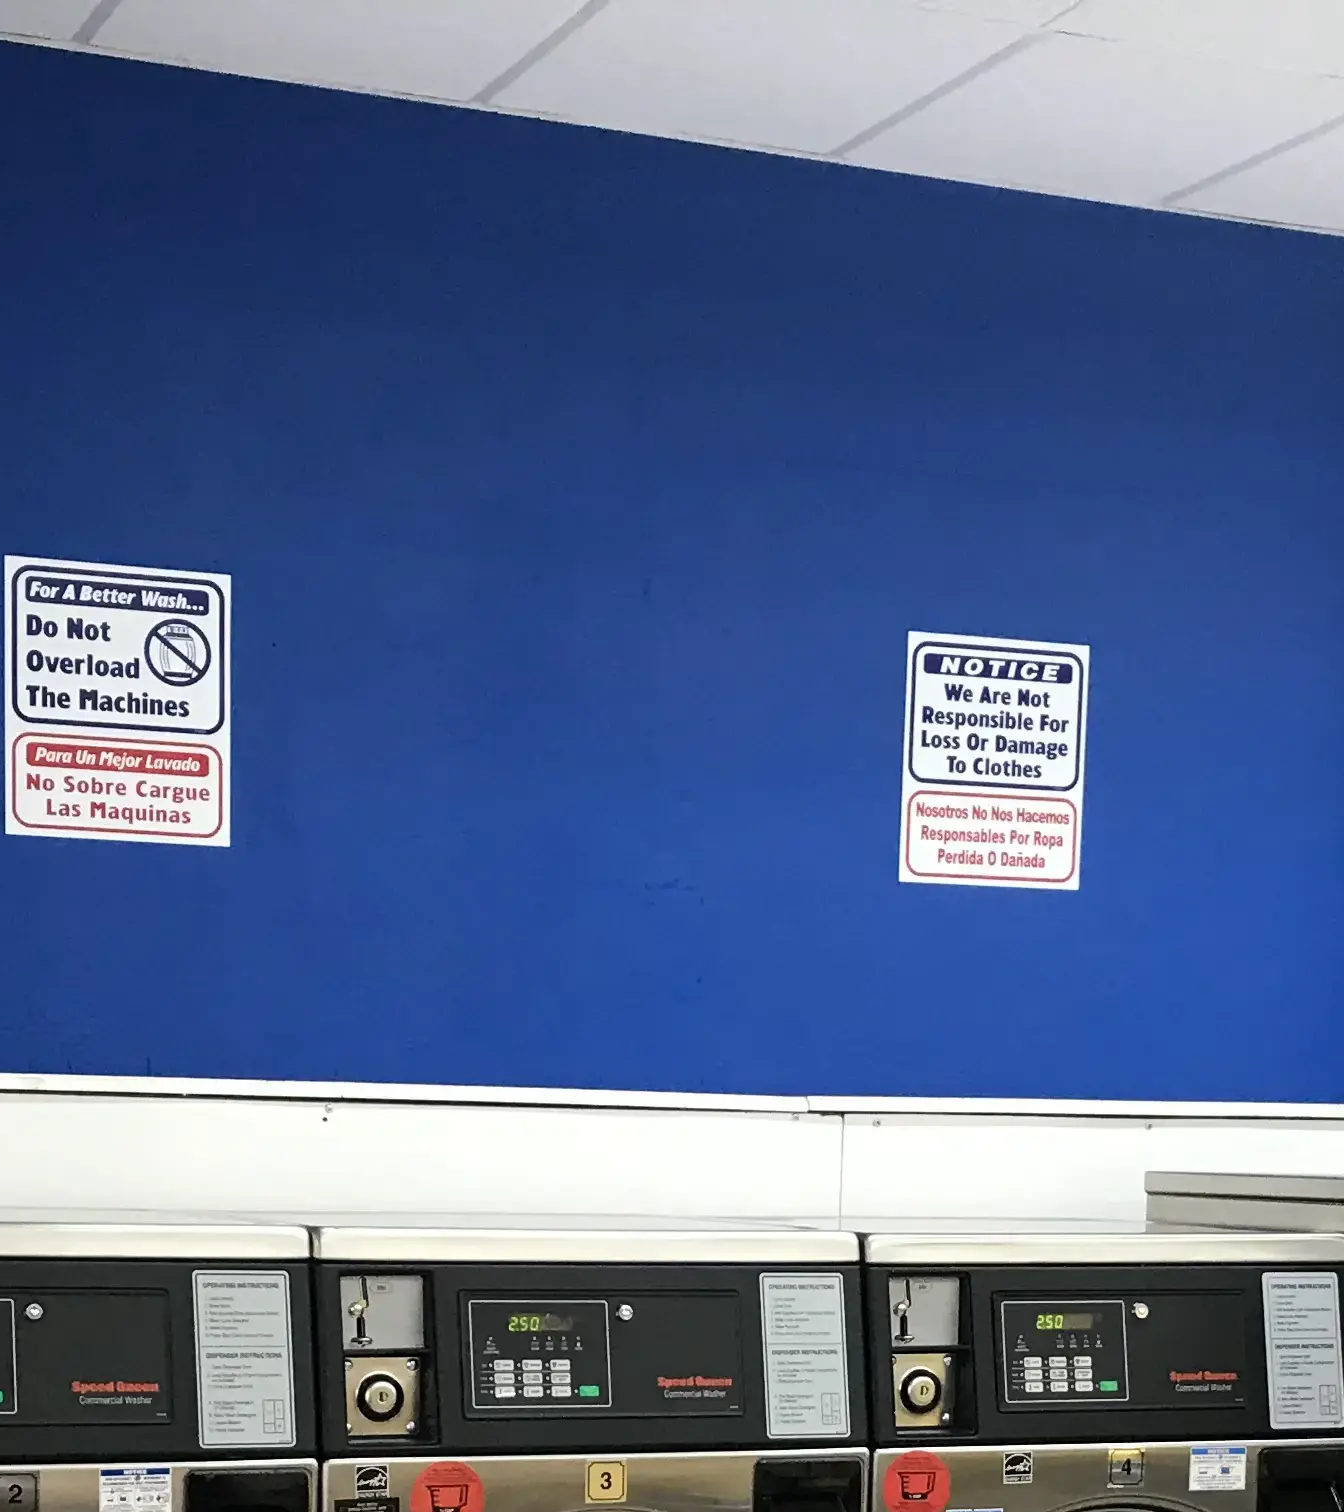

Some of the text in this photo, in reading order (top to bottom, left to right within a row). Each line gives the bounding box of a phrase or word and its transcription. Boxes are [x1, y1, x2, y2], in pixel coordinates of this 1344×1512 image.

[30, 580, 204, 611] For A Better Wash...
[26, 614, 111, 642] Do Not
[26, 650, 140, 679] Overload
[940, 656, 1060, 682] NOTICE
[26, 685, 190, 718] The Machines
[944, 683, 1050, 708] We Are Not
[922, 706, 1069, 733] Responsible For
[921, 730, 1068, 760] Loss Or Damage
[35, 747, 200, 772] Para Un Mejor Lavado
[947, 756, 1042, 778] To Clothes
[26, 773, 210, 804] No Sobre Cargue
[46, 799, 191, 825] Las Maquinas
[916, 802, 1069, 825] Nosotros No Nos Hacemos
[921, 825, 1063, 849] Responsables Por Ropa
[937, 849, 1045, 868] Perdida O Dañada
[72, 1380, 159, 1394] Speed Queen
[1121, 1458, 1132, 1476] 4
[8, 1483, 23, 1504] 2
[600, 1472, 613, 1490] 3
